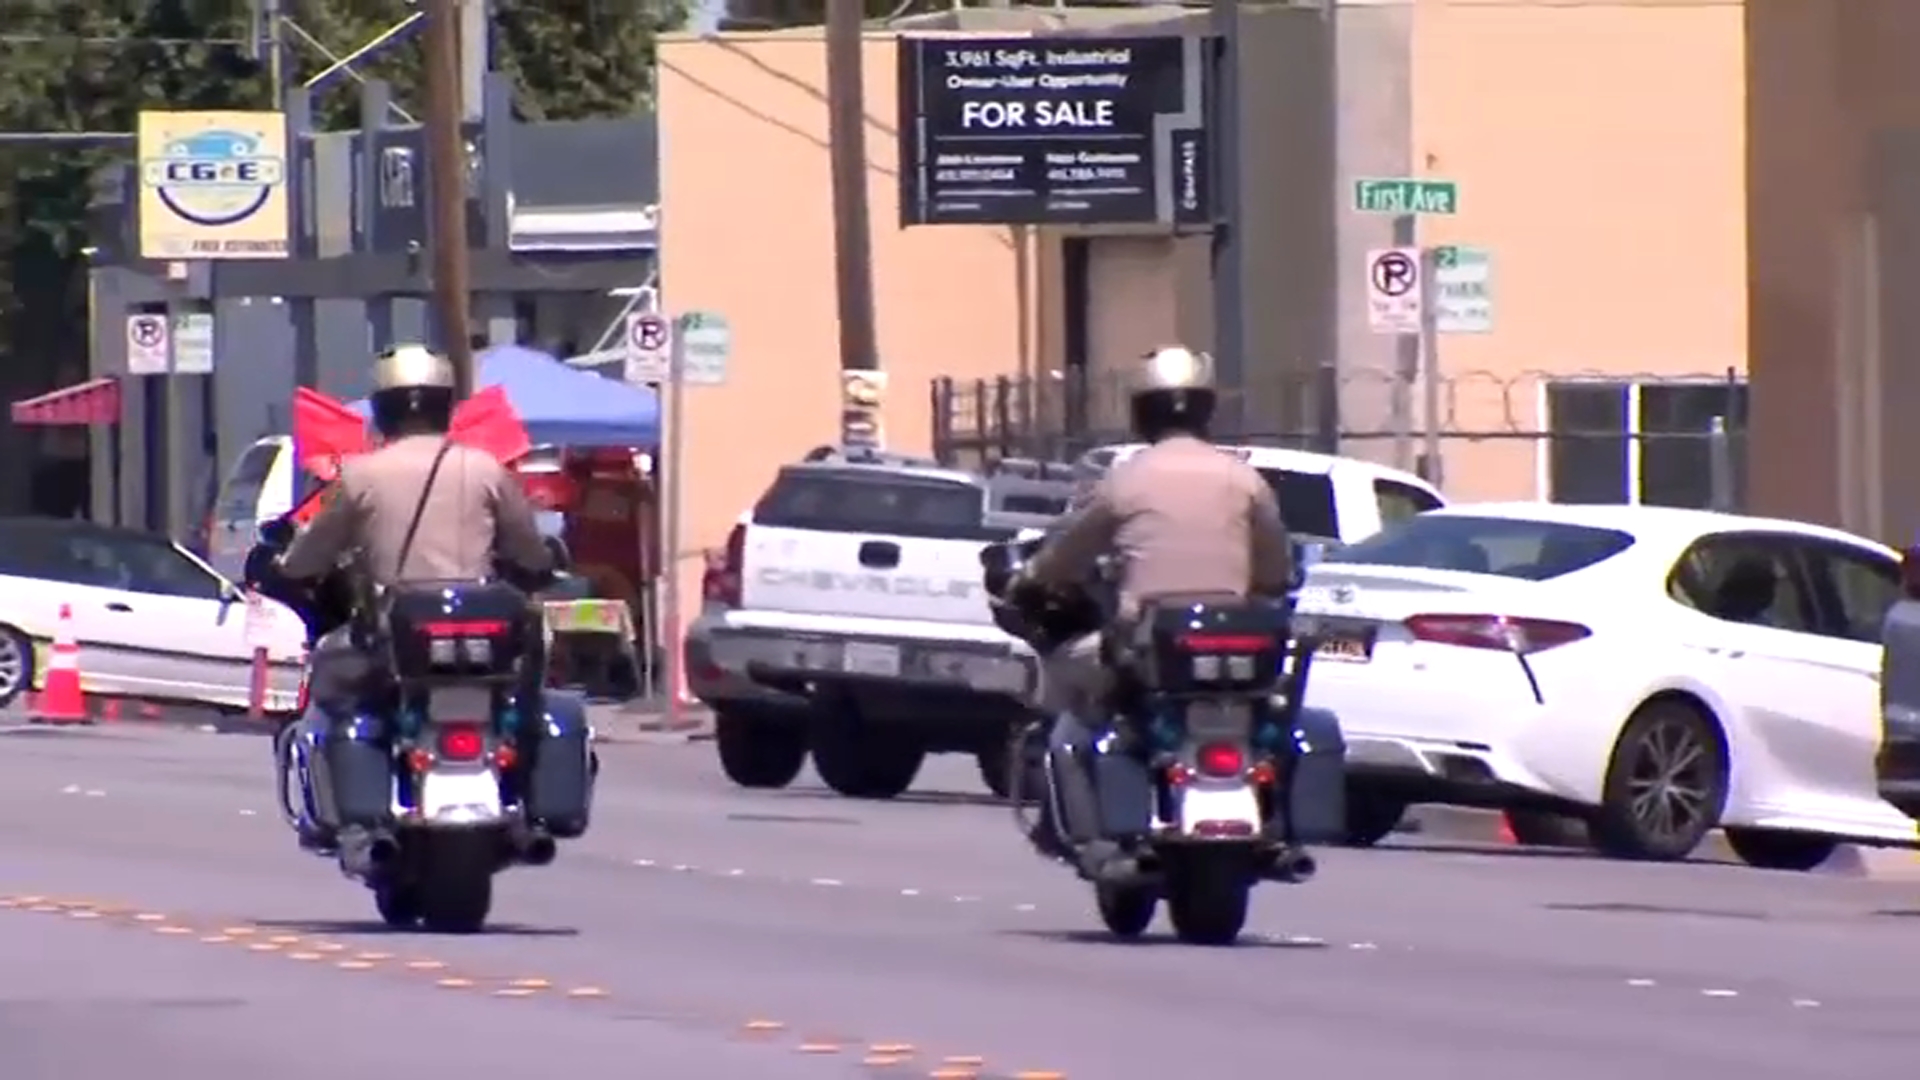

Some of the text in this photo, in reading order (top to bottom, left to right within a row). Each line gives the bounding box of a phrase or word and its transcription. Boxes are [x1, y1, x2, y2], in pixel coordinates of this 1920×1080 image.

[944, 50, 992, 68] 3,961
[1046, 48, 1131, 66] Industrial
[1039, 73, 1128, 89] Opportunity
[962, 100, 1114, 127] FOR SALE
[1360, 181, 1450, 211] First Ave
